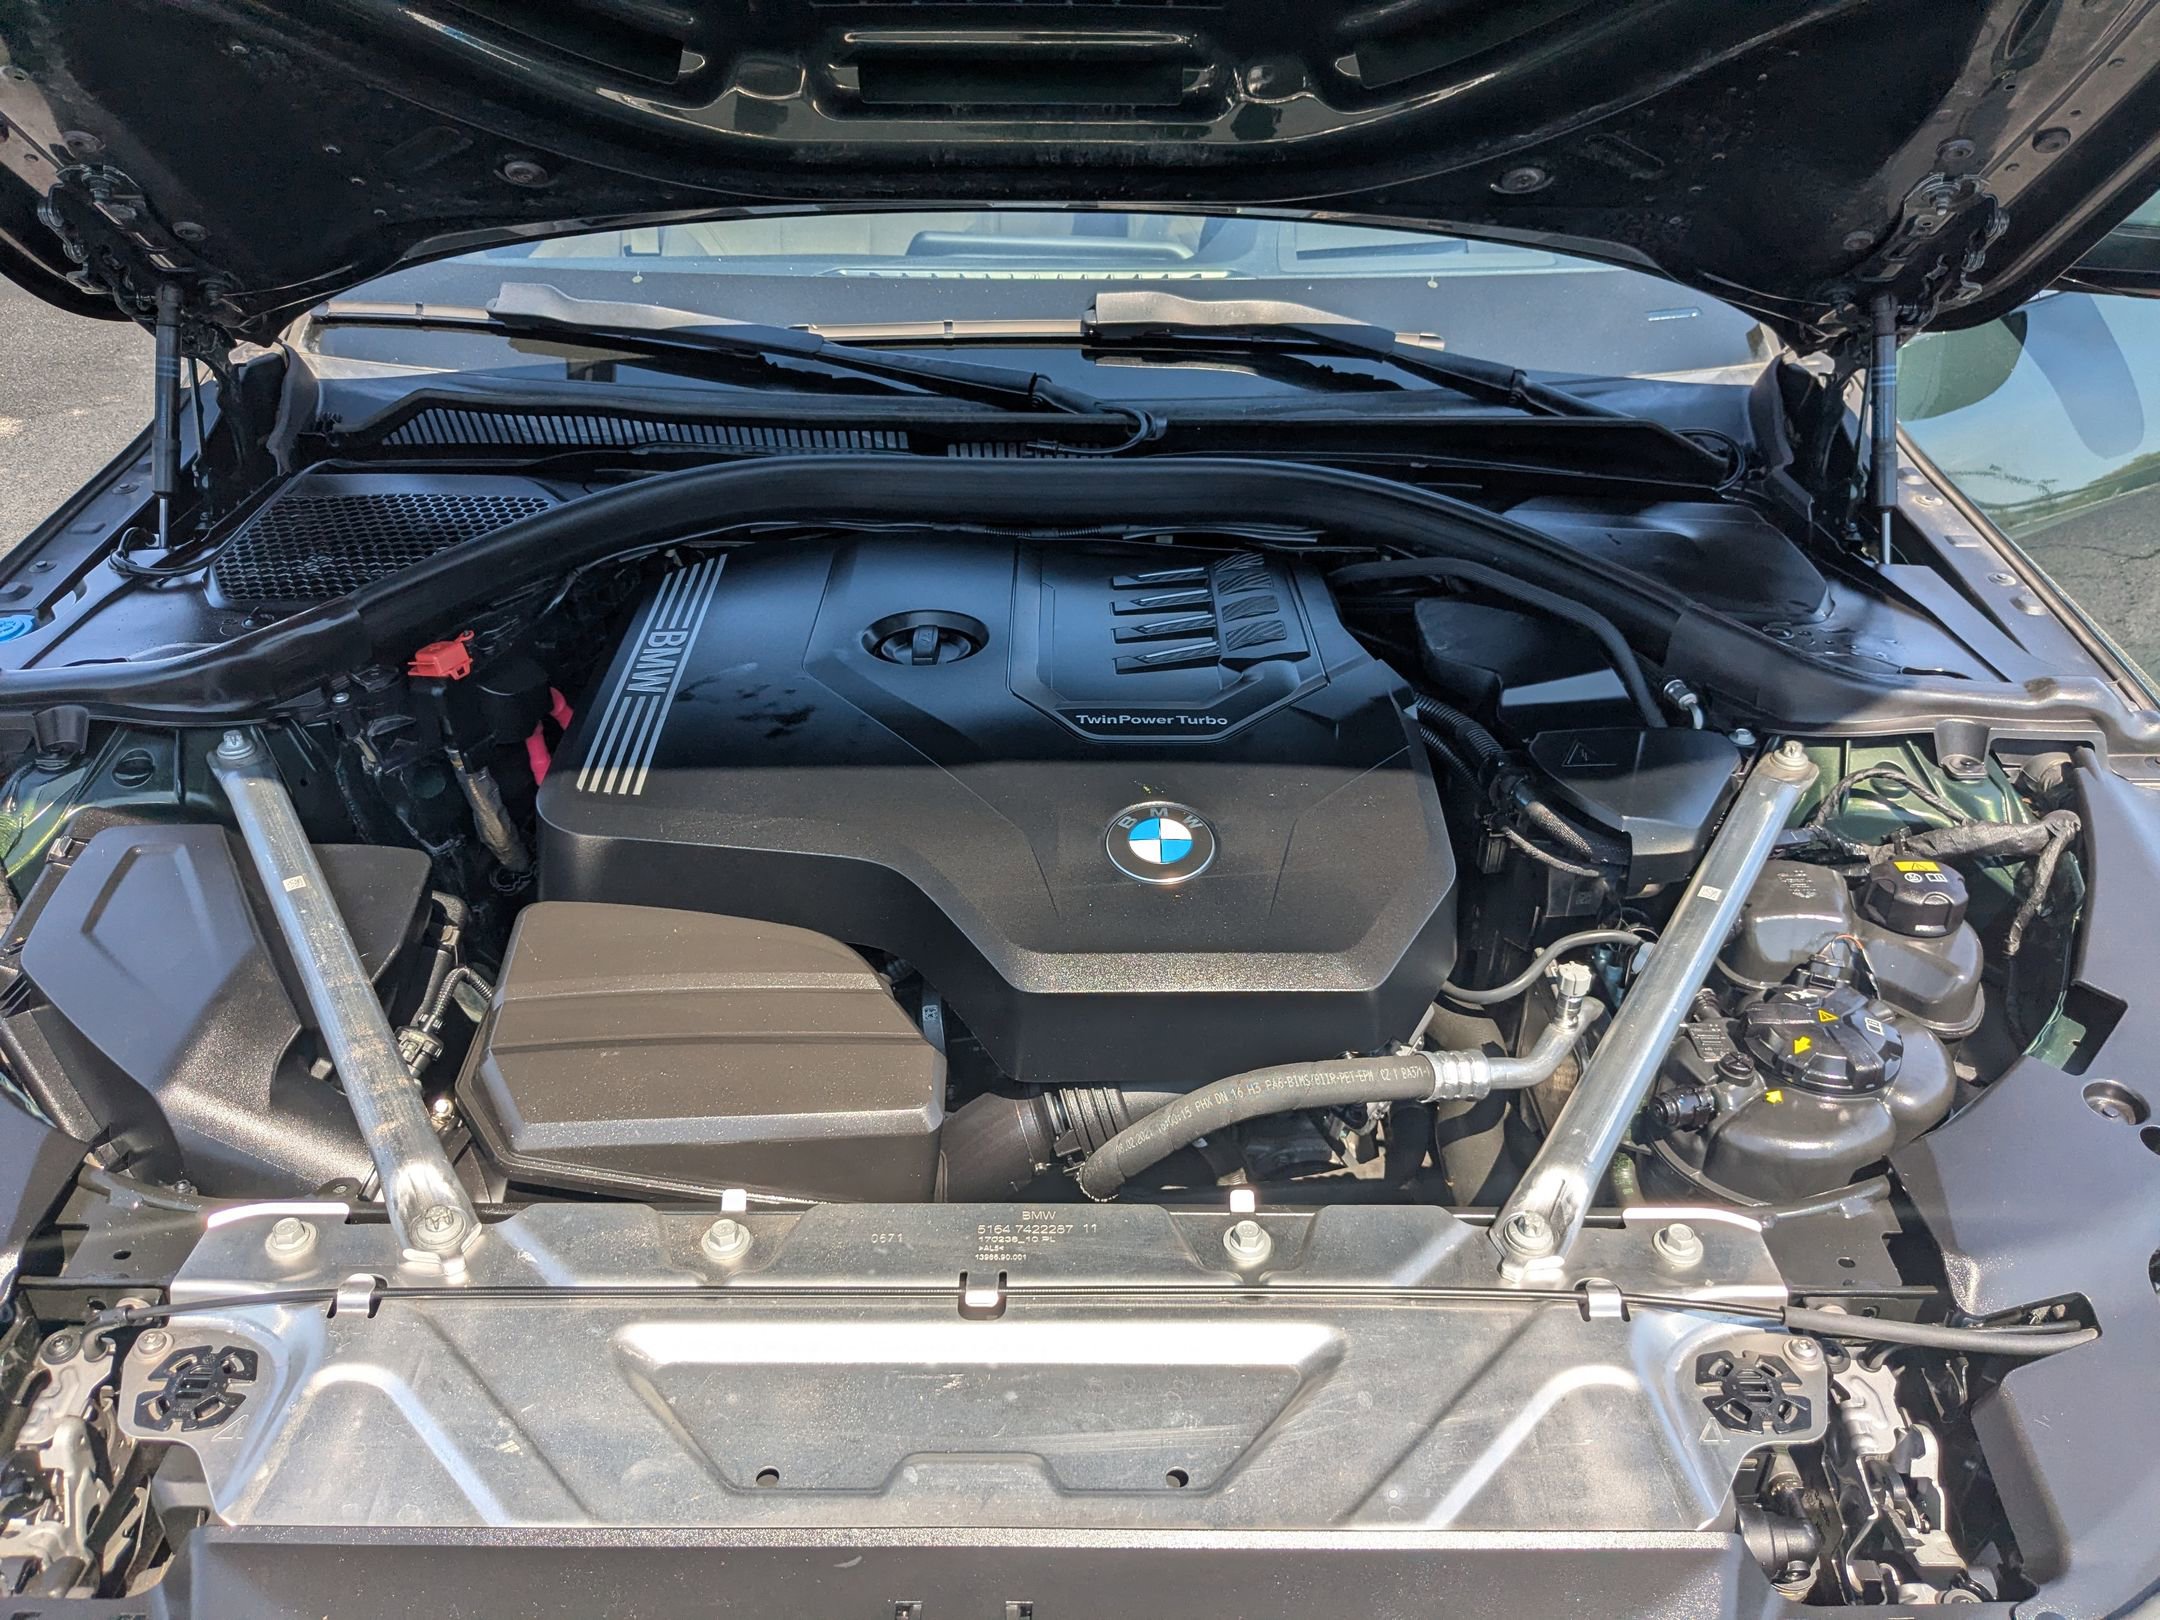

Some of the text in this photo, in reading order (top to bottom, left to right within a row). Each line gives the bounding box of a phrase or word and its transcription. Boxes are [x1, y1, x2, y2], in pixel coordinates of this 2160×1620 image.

[626, 630, 689, 693] BMW
[1075, 714, 1228, 726] TwinPower Turbo
[1117, 807, 1204, 830] BMW
[1214, 1089, 1229, 1104] DN
[1230, 1087, 1244, 1100] 16
[1246, 1081, 1262, 1096] H3
[1022, 1210, 1057, 1221] BMW
[977, 1223, 1097, 1235] 5164 7422287 11
